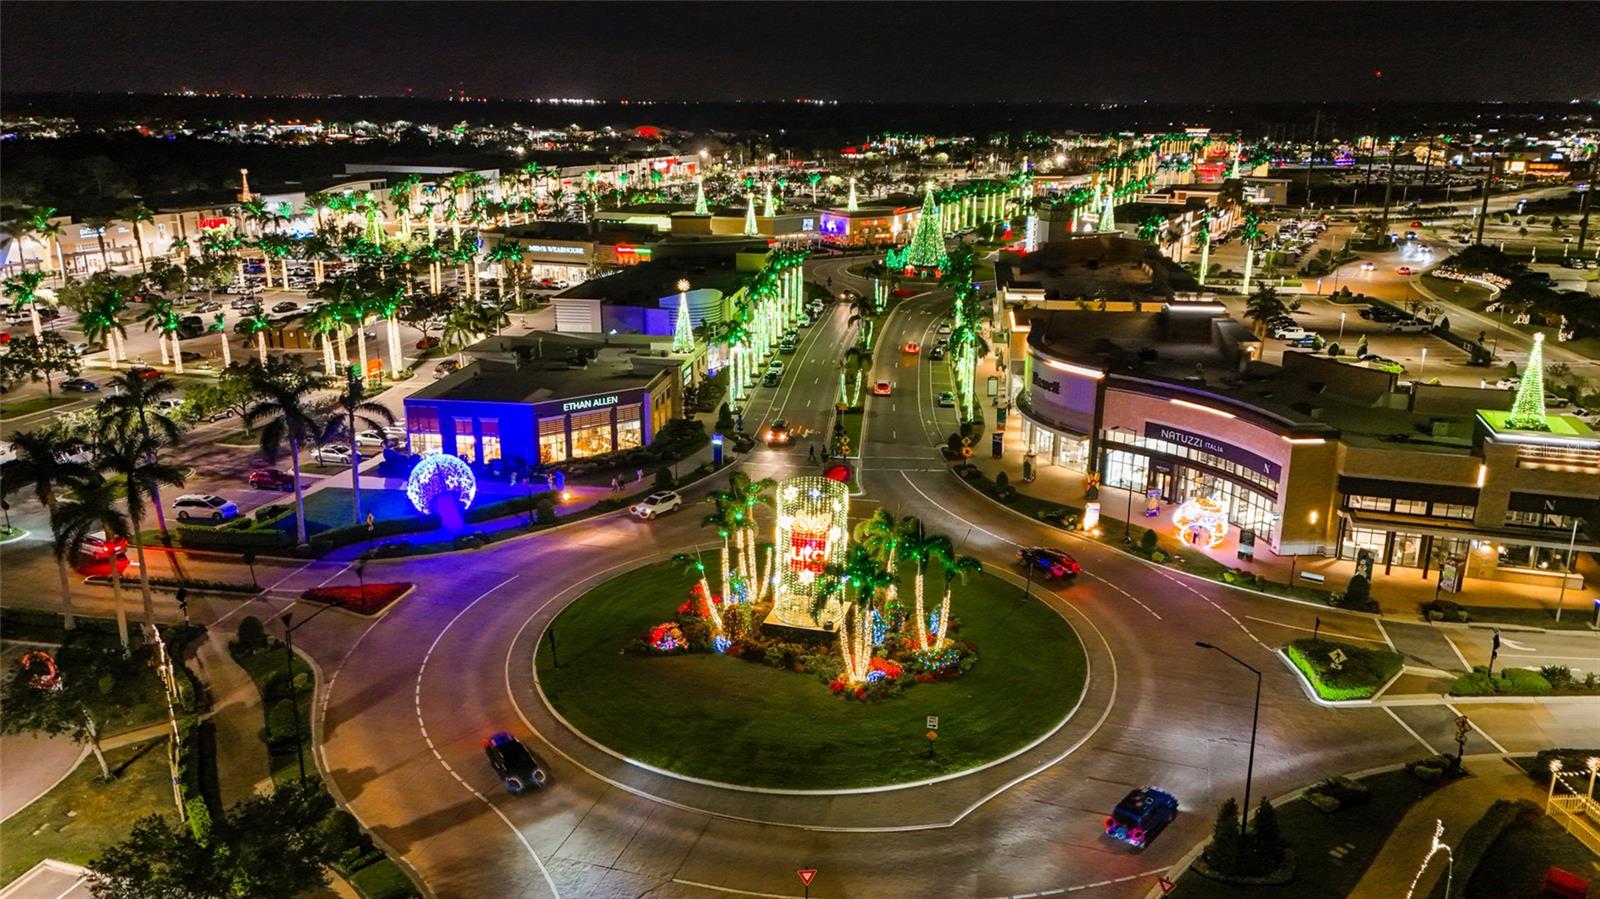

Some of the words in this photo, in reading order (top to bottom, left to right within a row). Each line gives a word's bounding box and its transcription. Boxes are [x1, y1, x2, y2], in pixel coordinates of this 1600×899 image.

[563, 400, 592, 411] ETHAN
[593, 396, 619, 407] ALLEN
[1161, 429, 1204, 448] NATUZZI
[1204, 441, 1224, 454] ITALIA
